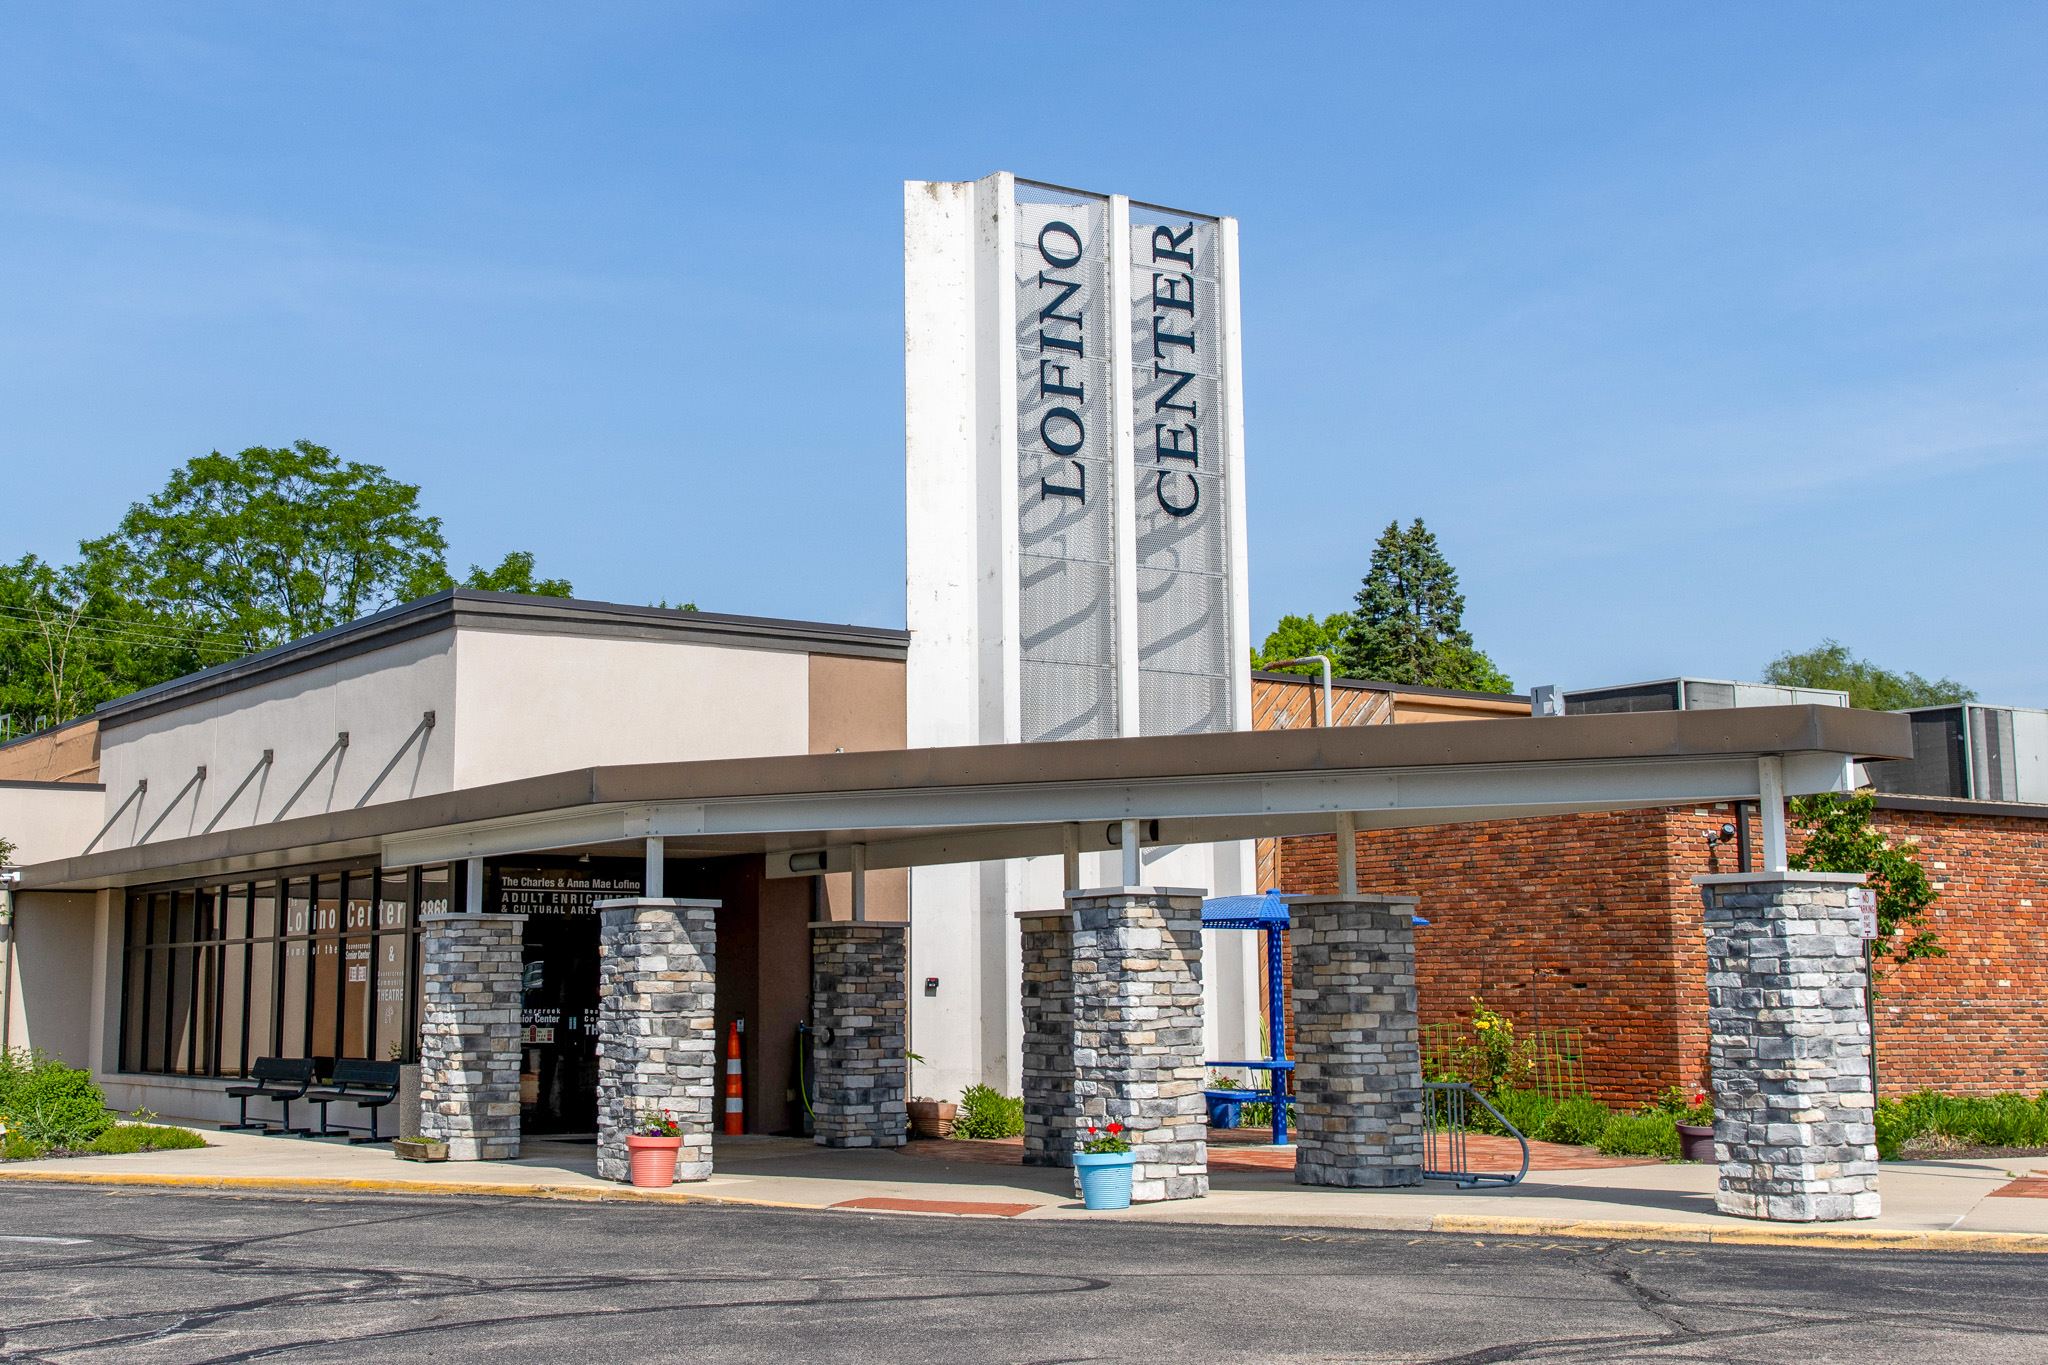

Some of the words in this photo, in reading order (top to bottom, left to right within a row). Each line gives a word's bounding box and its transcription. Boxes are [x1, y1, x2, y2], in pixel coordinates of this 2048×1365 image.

[1038, 221, 1086, 505] LOFINO
[1152, 221, 1200, 518] CENTER
[502, 876, 518, 887] The
[520, 877, 555, 888] Charles
[557, 878, 564, 888] &
[567, 878, 590, 888] Anna
[592, 879, 611, 889] Mae
[613, 879, 640, 889] Lofino
[501, 892, 544, 903] ADULT
[552, 893, 639, 904] ENRICH
[501, 904, 508, 913] &
[513, 904, 566, 914] CULTURAL
[570, 905, 597, 915] ARTS
[288, 904, 336, 931] Lofino
[388, 945, 395, 962] &
[534, 1013, 560, 1023] Center
